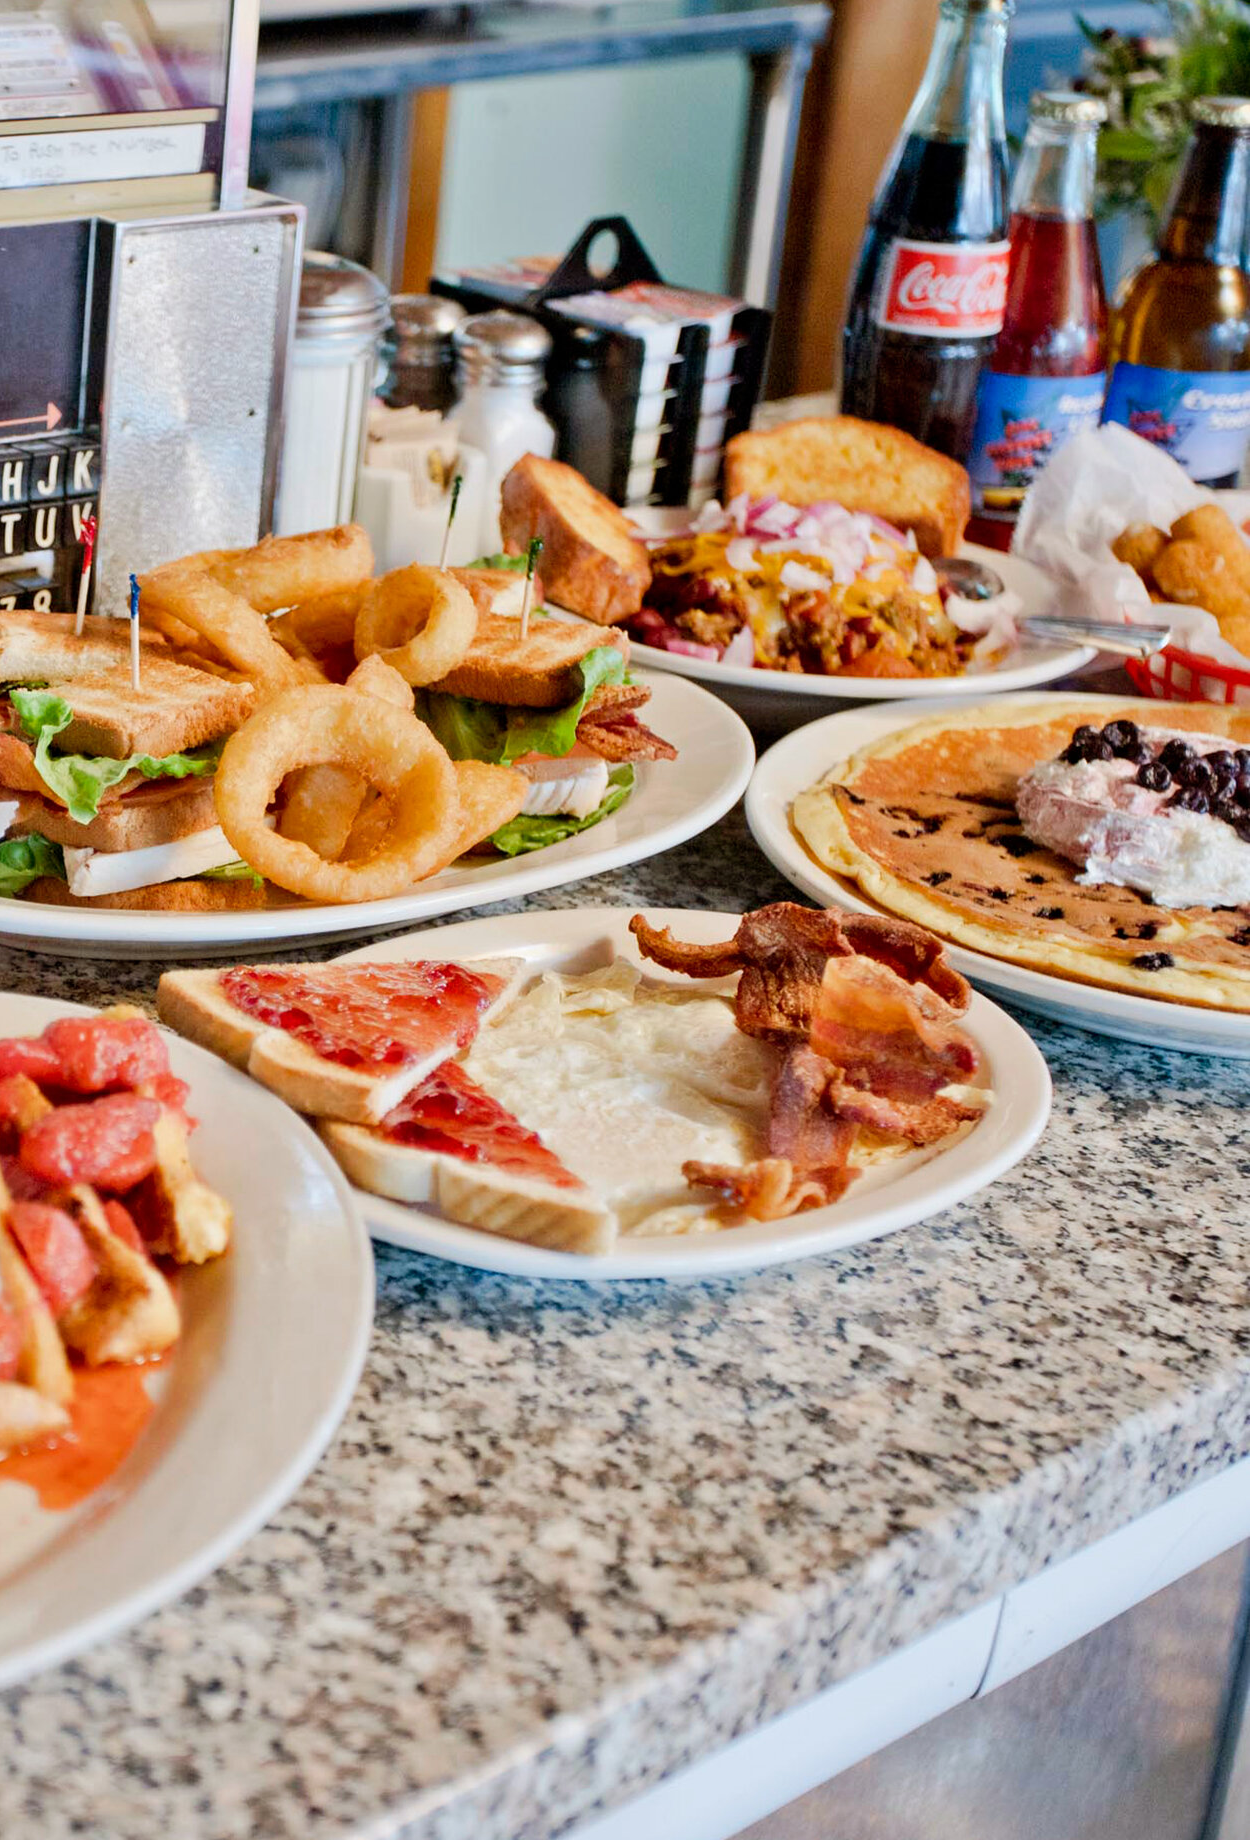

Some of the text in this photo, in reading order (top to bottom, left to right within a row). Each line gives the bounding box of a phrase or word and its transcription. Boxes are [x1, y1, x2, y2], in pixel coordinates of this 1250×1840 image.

[3, 462, 22, 502] H
[38, 456, 58, 496] J
[74, 451, 92, 491] K
[1, 514, 21, 553] T
[36, 508, 56, 547] U
